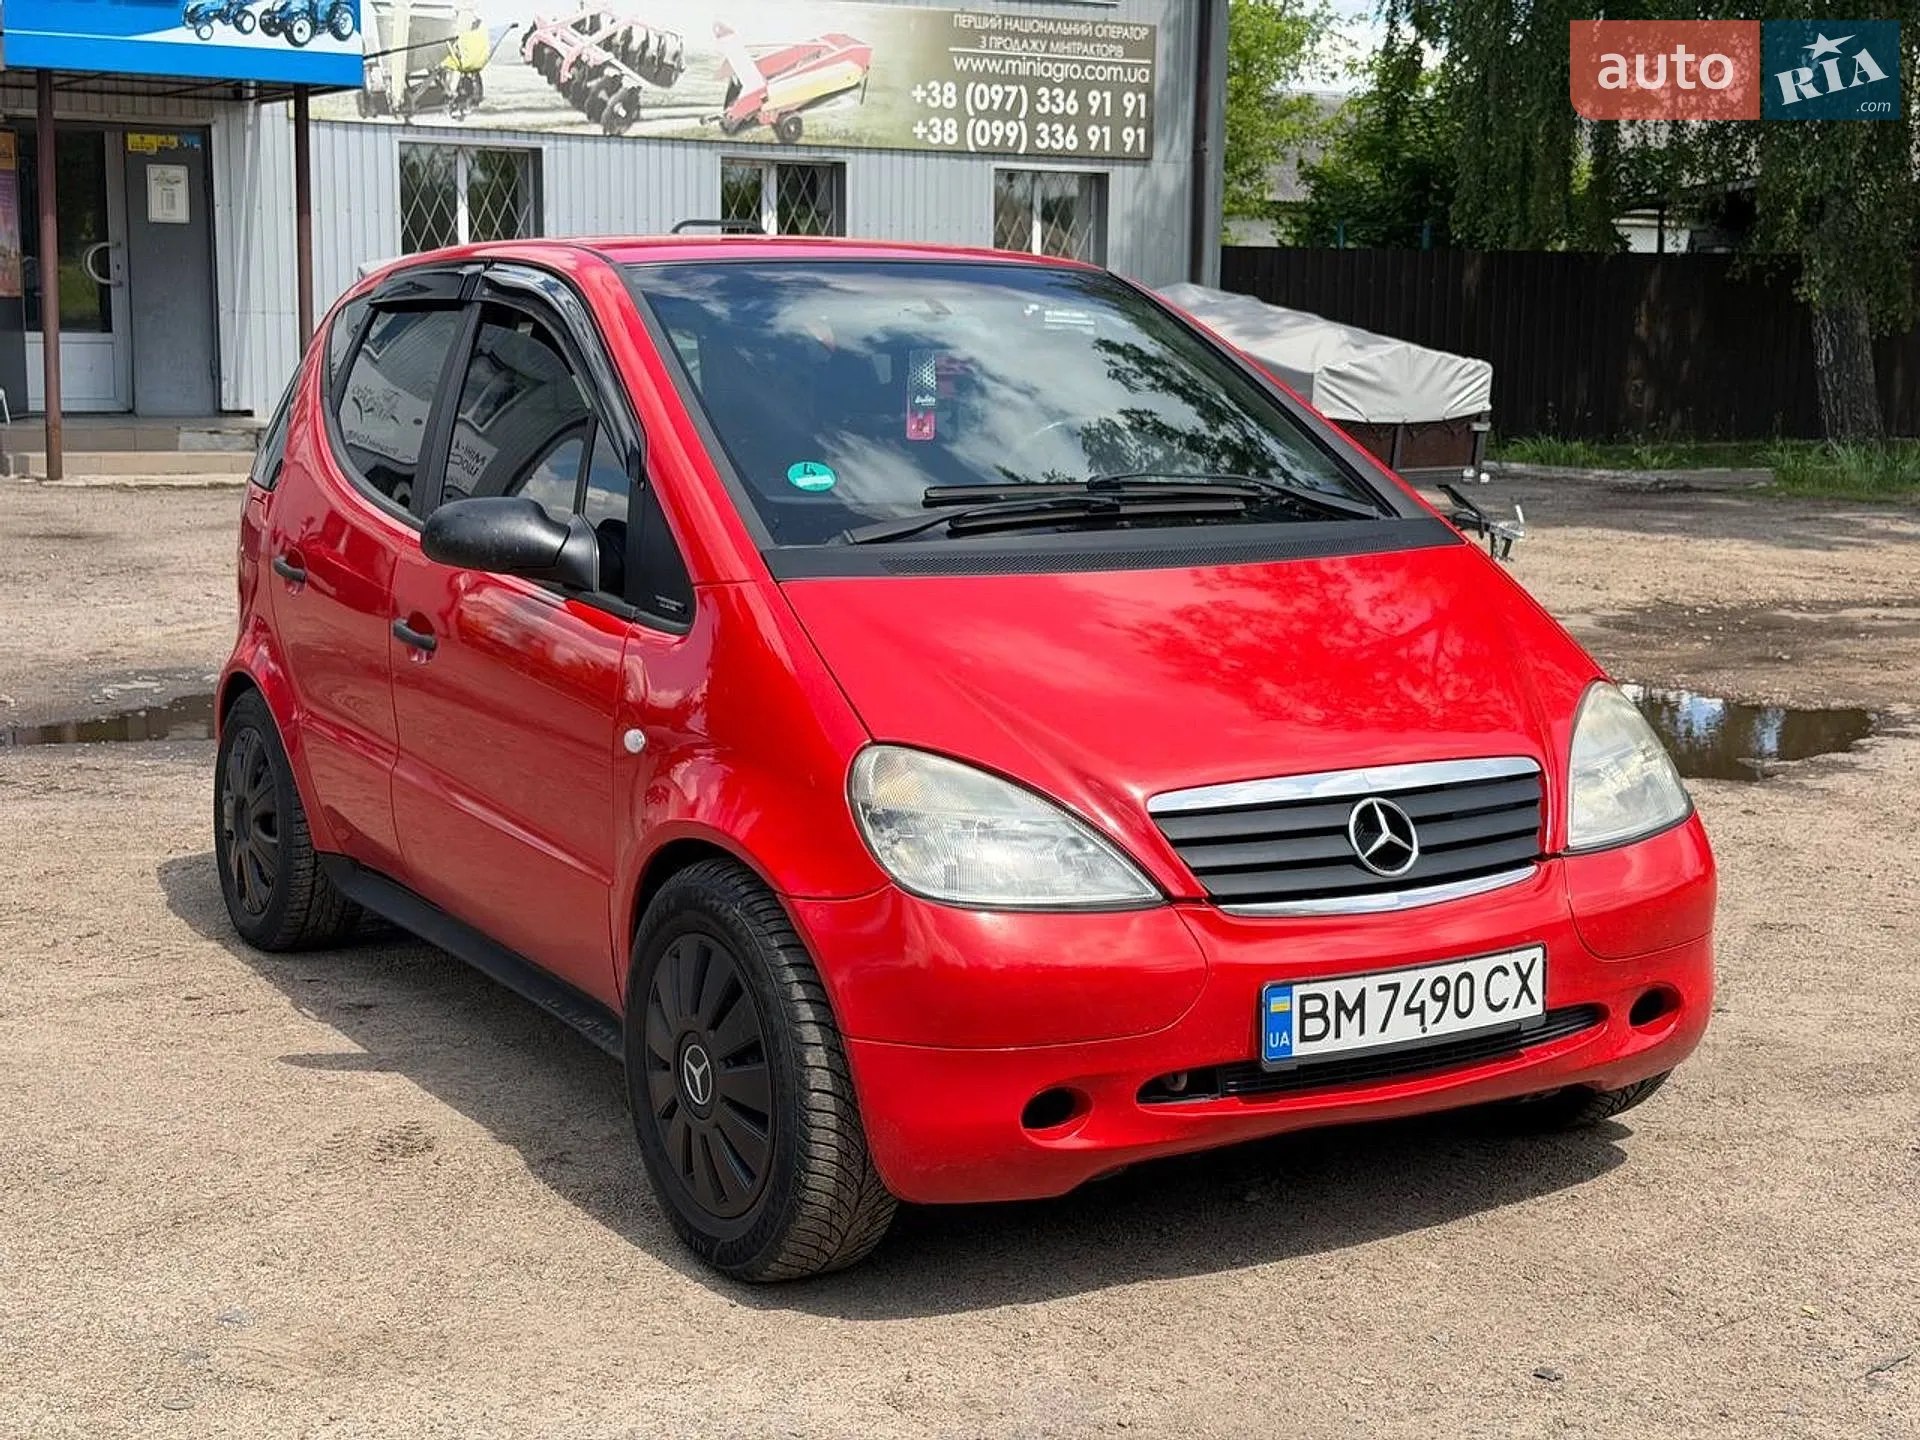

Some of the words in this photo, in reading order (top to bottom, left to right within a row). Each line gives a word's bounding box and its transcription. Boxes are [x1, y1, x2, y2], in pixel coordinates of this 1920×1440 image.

[953, 13, 1002, 30] ПЕРШИЙ
[1095, 23, 1150, 40] ОПЕРАТОР
[989, 36, 1047, 52] ПРОДАЖУ
[953, 55, 1150, 84] www.miniagro.com.ua
[911, 81, 957, 108] +38
[965, 82, 1028, 118] (097)
[1035, 87, 1079, 116] 336
[1087, 90, 1111, 117] 91
[1122, 91, 1146, 118] 91
[912, 117, 958, 145] +38
[966, 118, 1027, 153] (099)
[1035, 123, 1078, 151] 336
[1087, 126, 1110, 152] 91
[1122, 127, 1145, 153] 91
[1298, 986, 1367, 1043] BM
[1377, 970, 1475, 1034] 7490
[1484, 957, 1538, 1013] CX
[1269, 1032, 1291, 1048] UA
